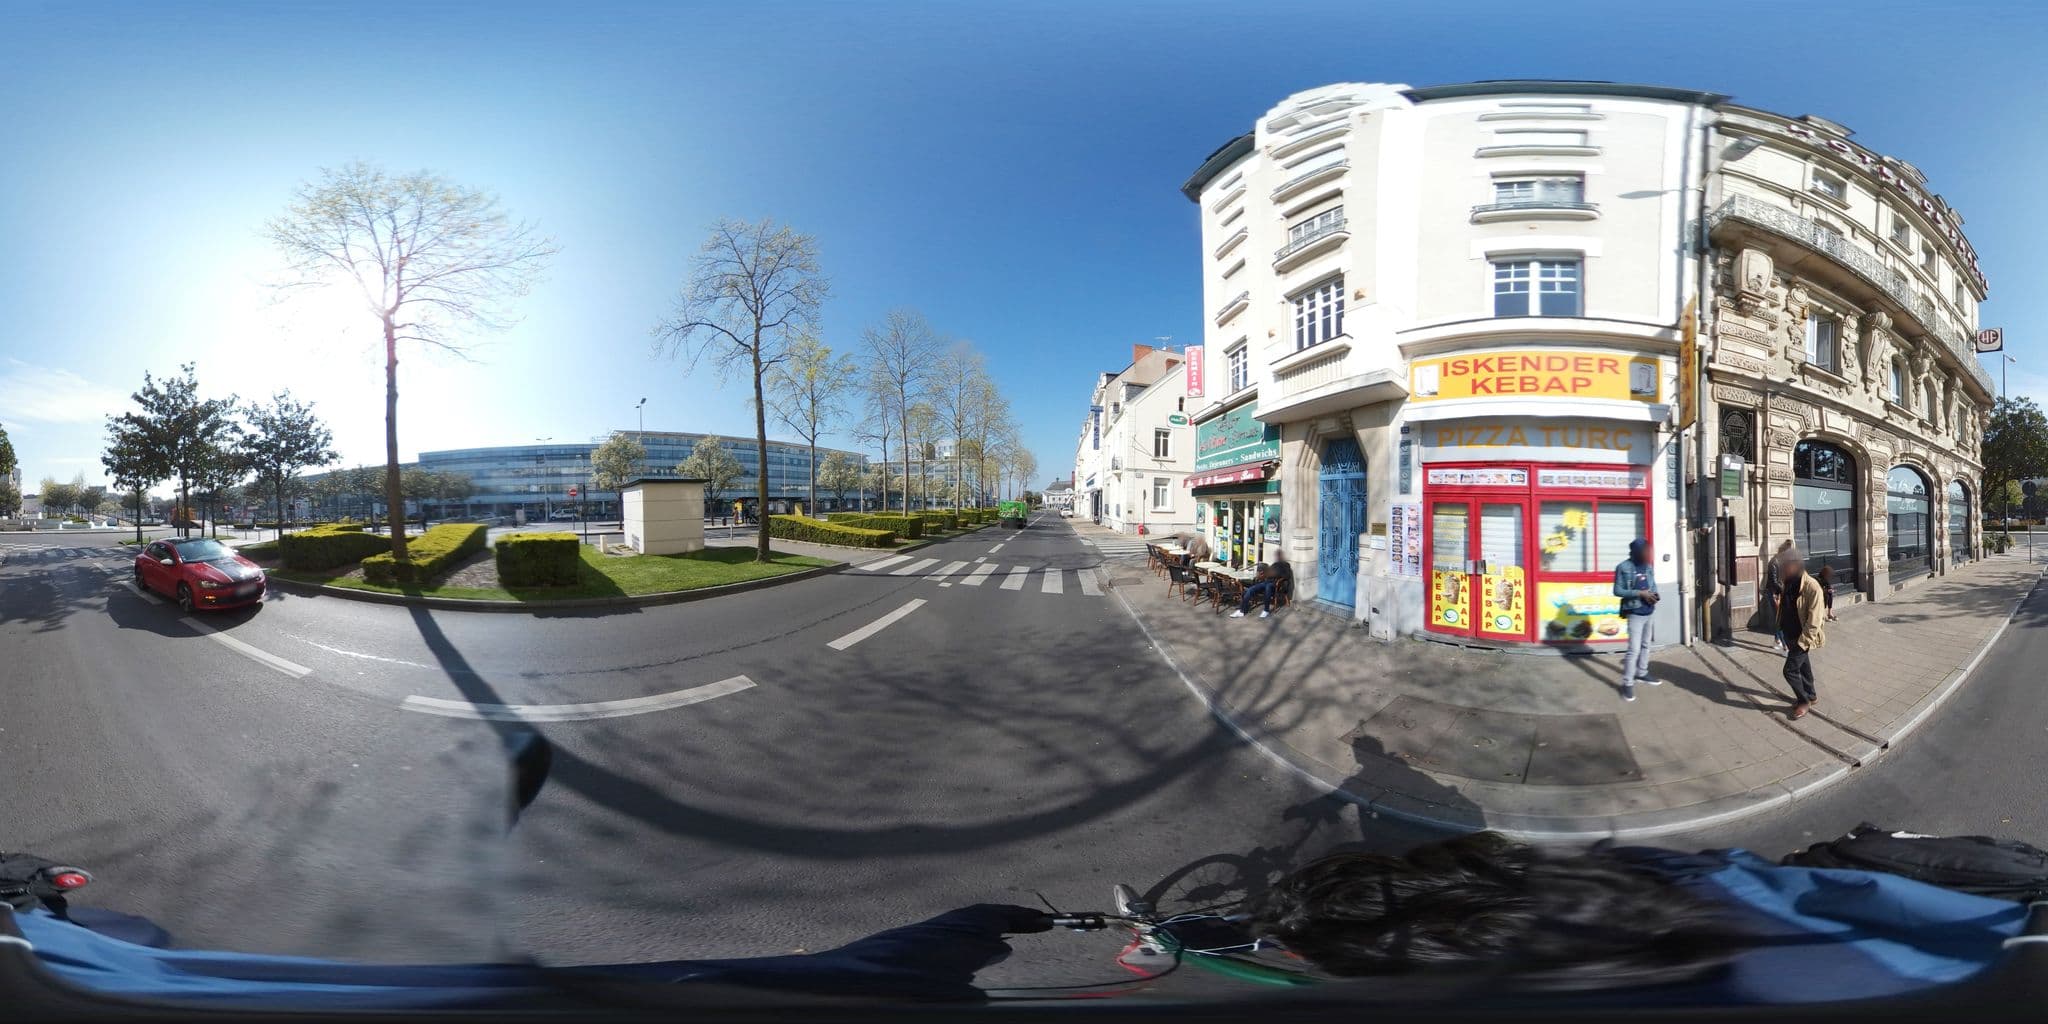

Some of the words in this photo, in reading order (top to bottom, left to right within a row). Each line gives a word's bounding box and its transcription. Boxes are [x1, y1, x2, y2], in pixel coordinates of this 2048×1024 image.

[1981, 330, 1999, 344] HF
[1442, 355, 1621, 377] ISKENDER
[1471, 375, 1593, 395] KEBAP
[1437, 424, 1530, 448] PIZZA
[1536, 424, 1634, 451] TURC
[1816, 491, 1832, 505] Bar
